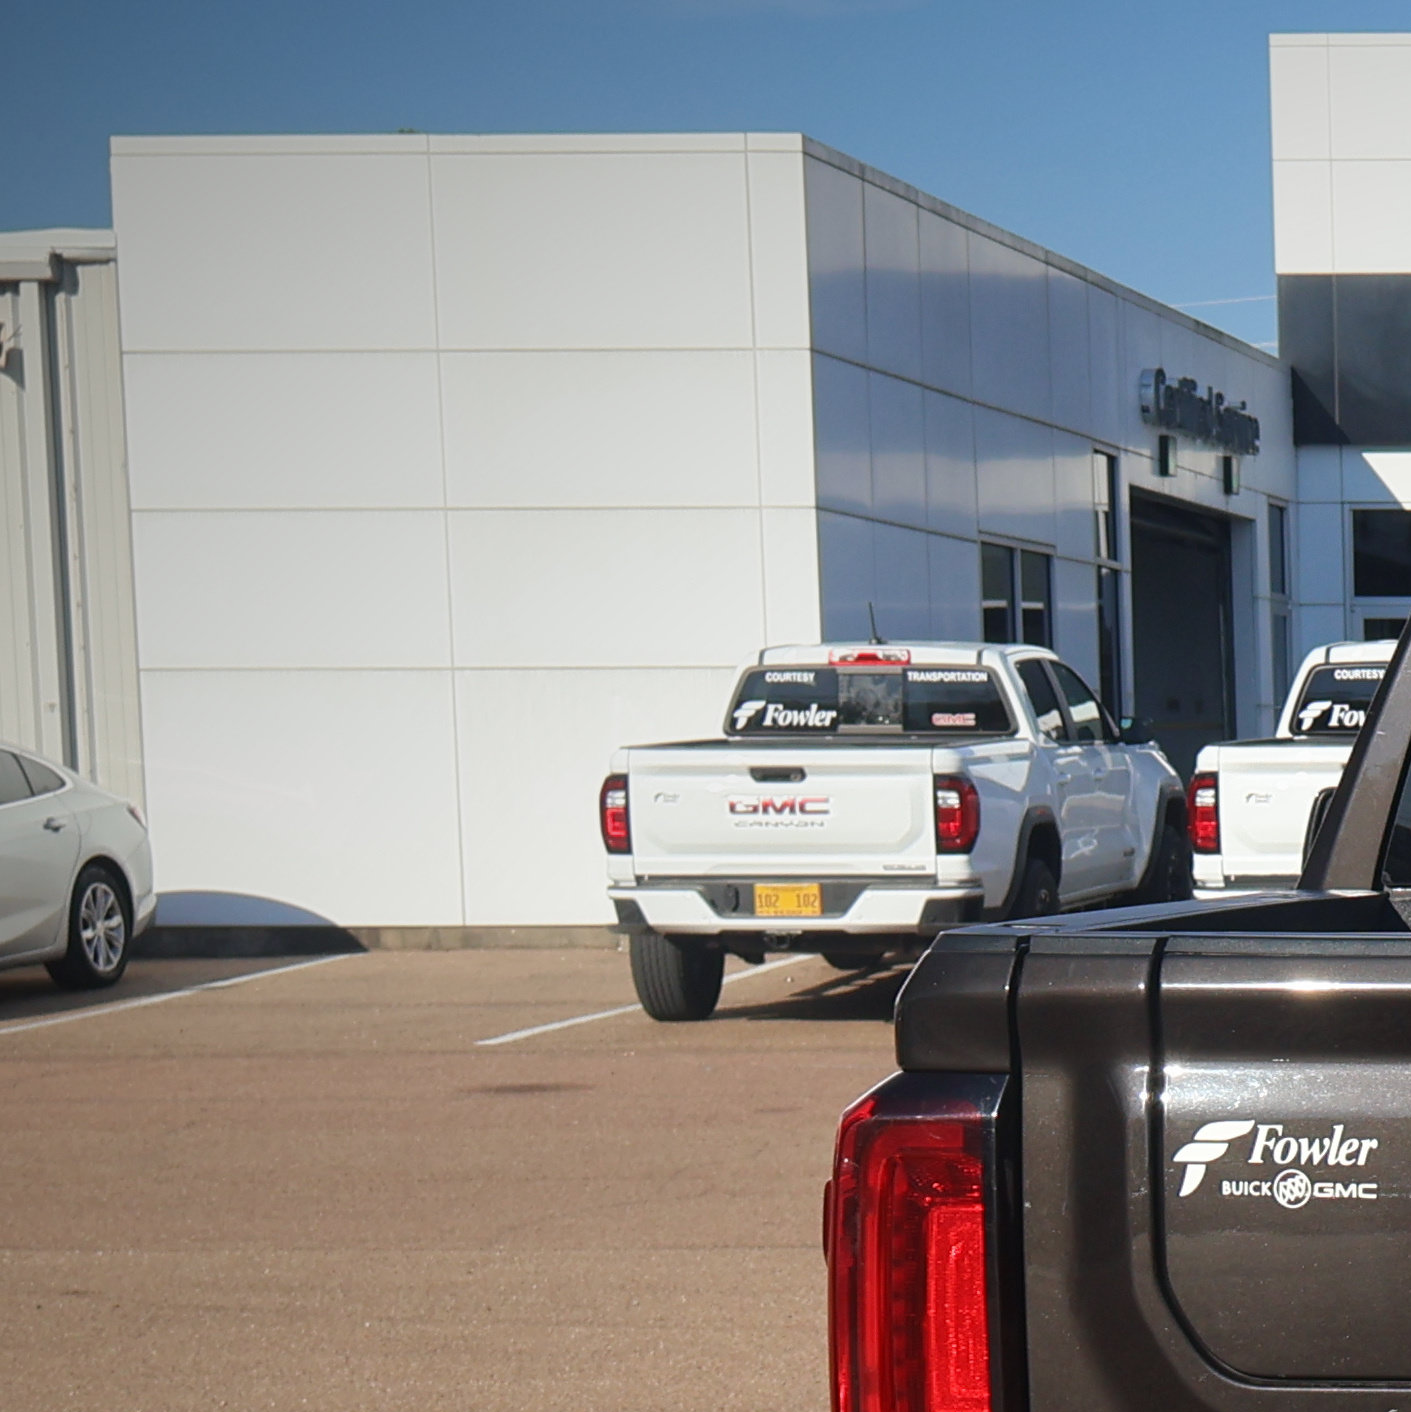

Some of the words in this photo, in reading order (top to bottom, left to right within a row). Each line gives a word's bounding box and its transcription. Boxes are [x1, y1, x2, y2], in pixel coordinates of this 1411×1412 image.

[765, 671, 815, 683] COURTESY
[906, 671, 988, 682] TRANSPORTATION
[763, 703, 837, 727] Fowler
[728, 796, 830, 815] GMC
[1248, 1124, 1379, 1166] Fowler
[1222, 1180, 1273, 1196] BUICK
[1313, 1182, 1377, 1199] GMC
